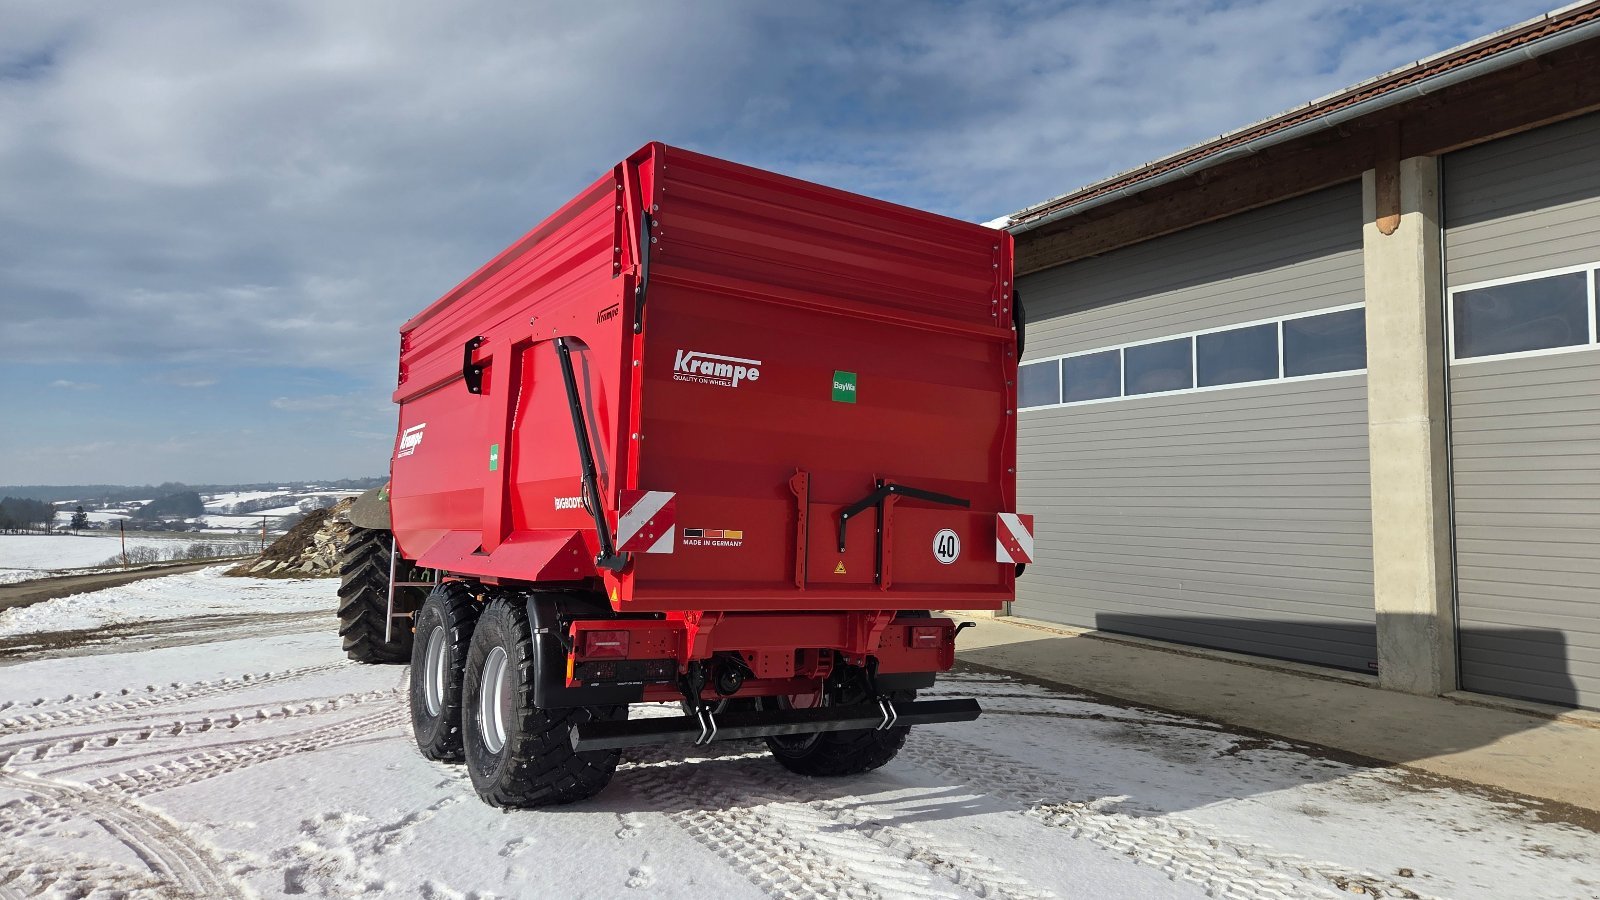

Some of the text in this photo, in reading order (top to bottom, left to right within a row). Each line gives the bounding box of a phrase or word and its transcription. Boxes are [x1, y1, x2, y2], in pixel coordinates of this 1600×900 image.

[674, 349, 761, 387] Krampe
[673, 374, 698, 383] QUALITY
[709, 379, 731, 387] WHEELS
[833, 381, 856, 391] BayWa
[937, 535, 955, 558] 40
